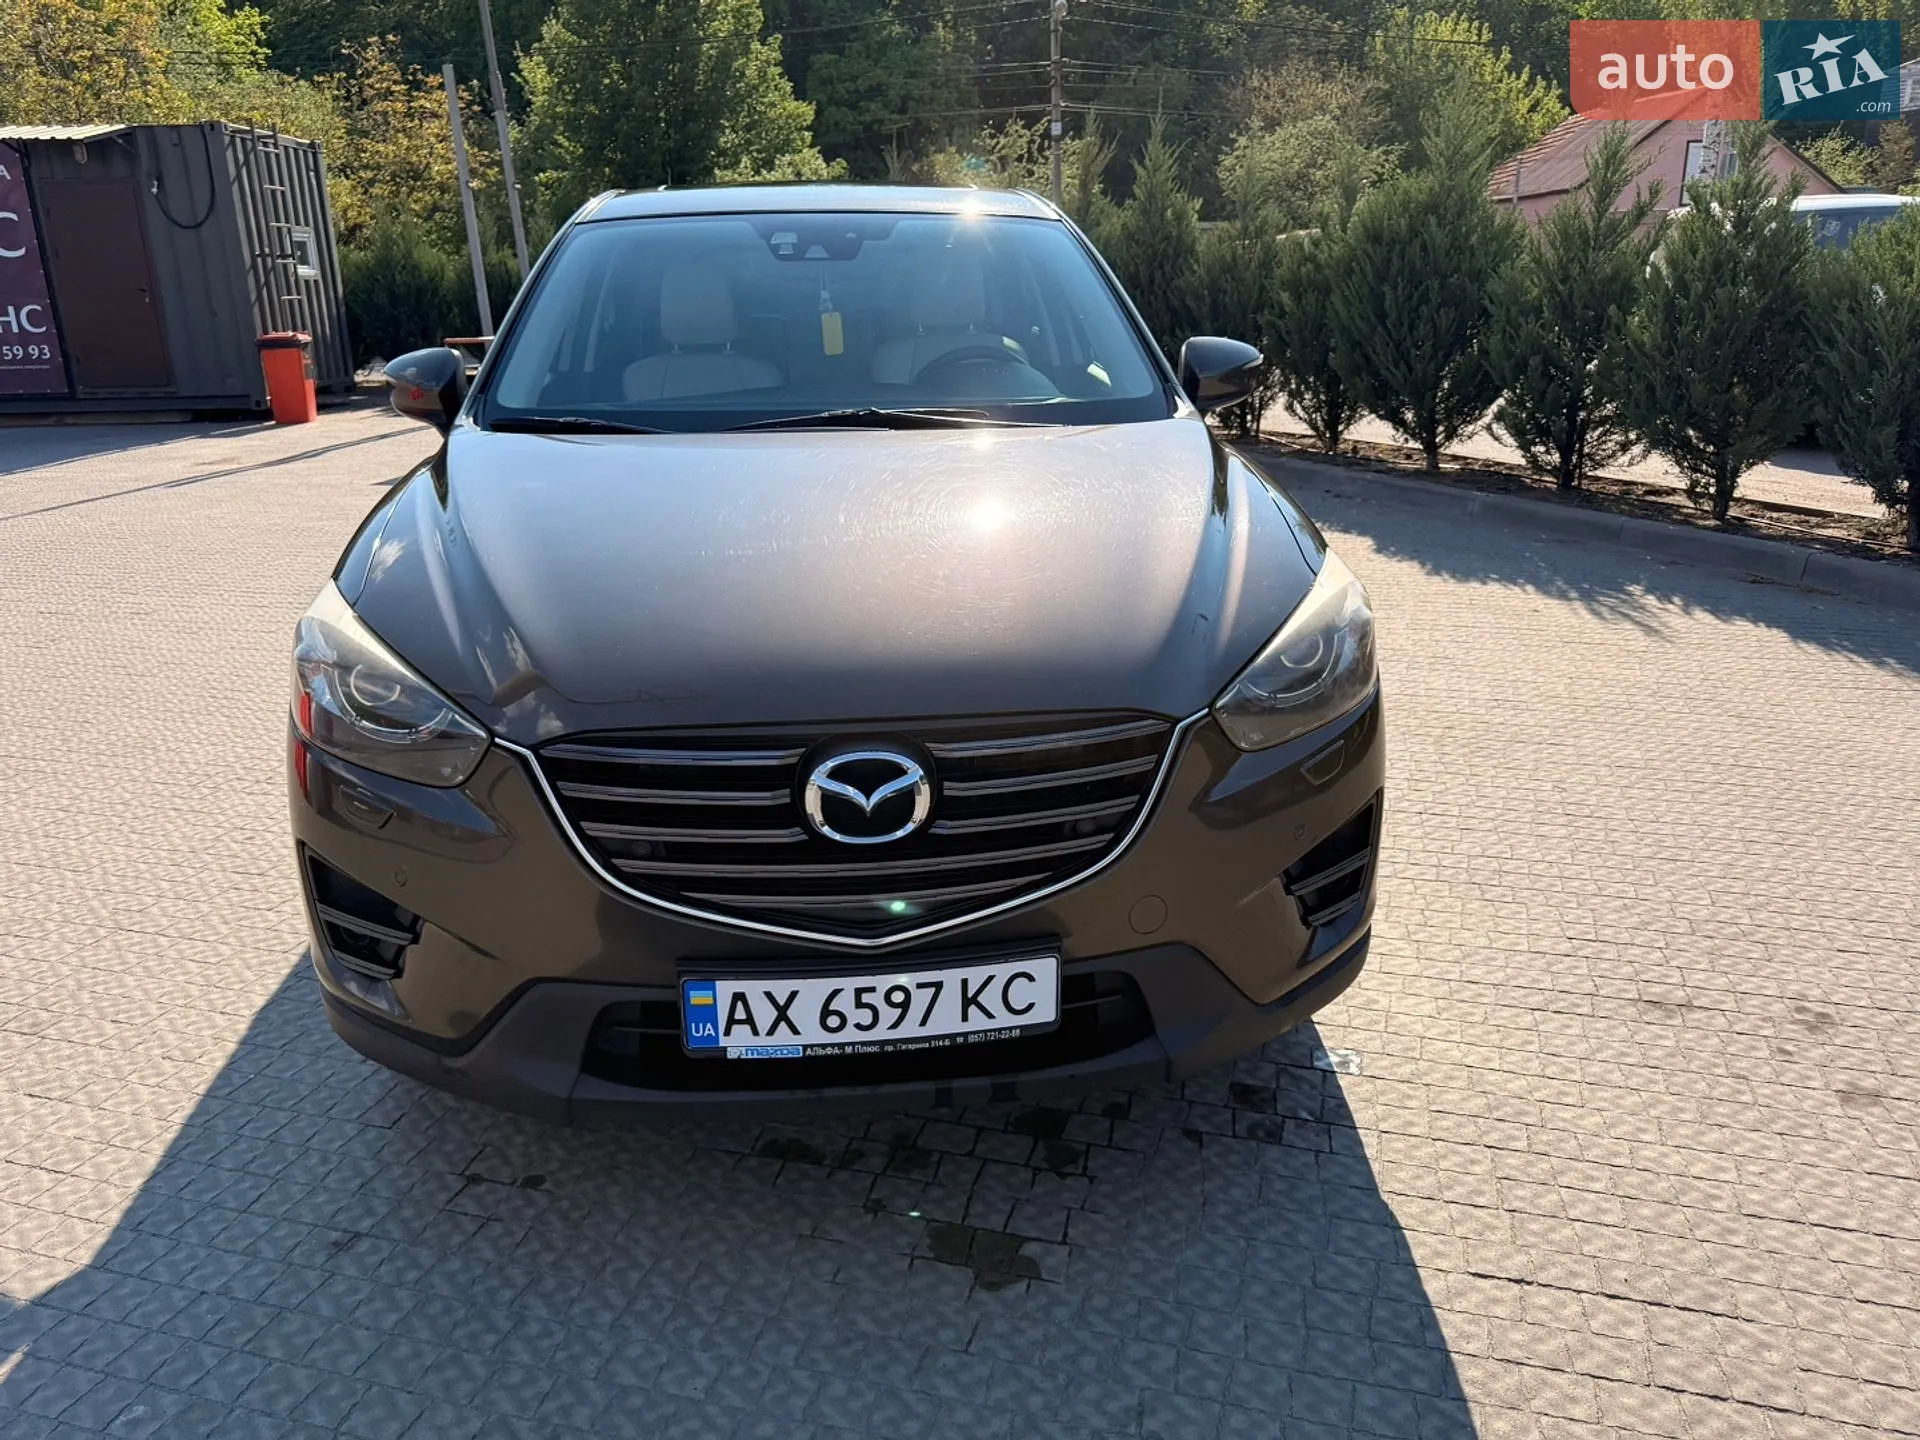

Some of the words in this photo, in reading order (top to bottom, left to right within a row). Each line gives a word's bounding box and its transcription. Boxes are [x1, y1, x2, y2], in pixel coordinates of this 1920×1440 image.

[2, 345, 24, 360] 59
[28, 344, 51, 359] 93
[722, 989, 802, 1038] AX
[818, 979, 945, 1034] 6597
[960, 970, 1038, 1024] KC
[691, 1022, 716, 1038] UA
[745, 1047, 801, 1058] mazda
